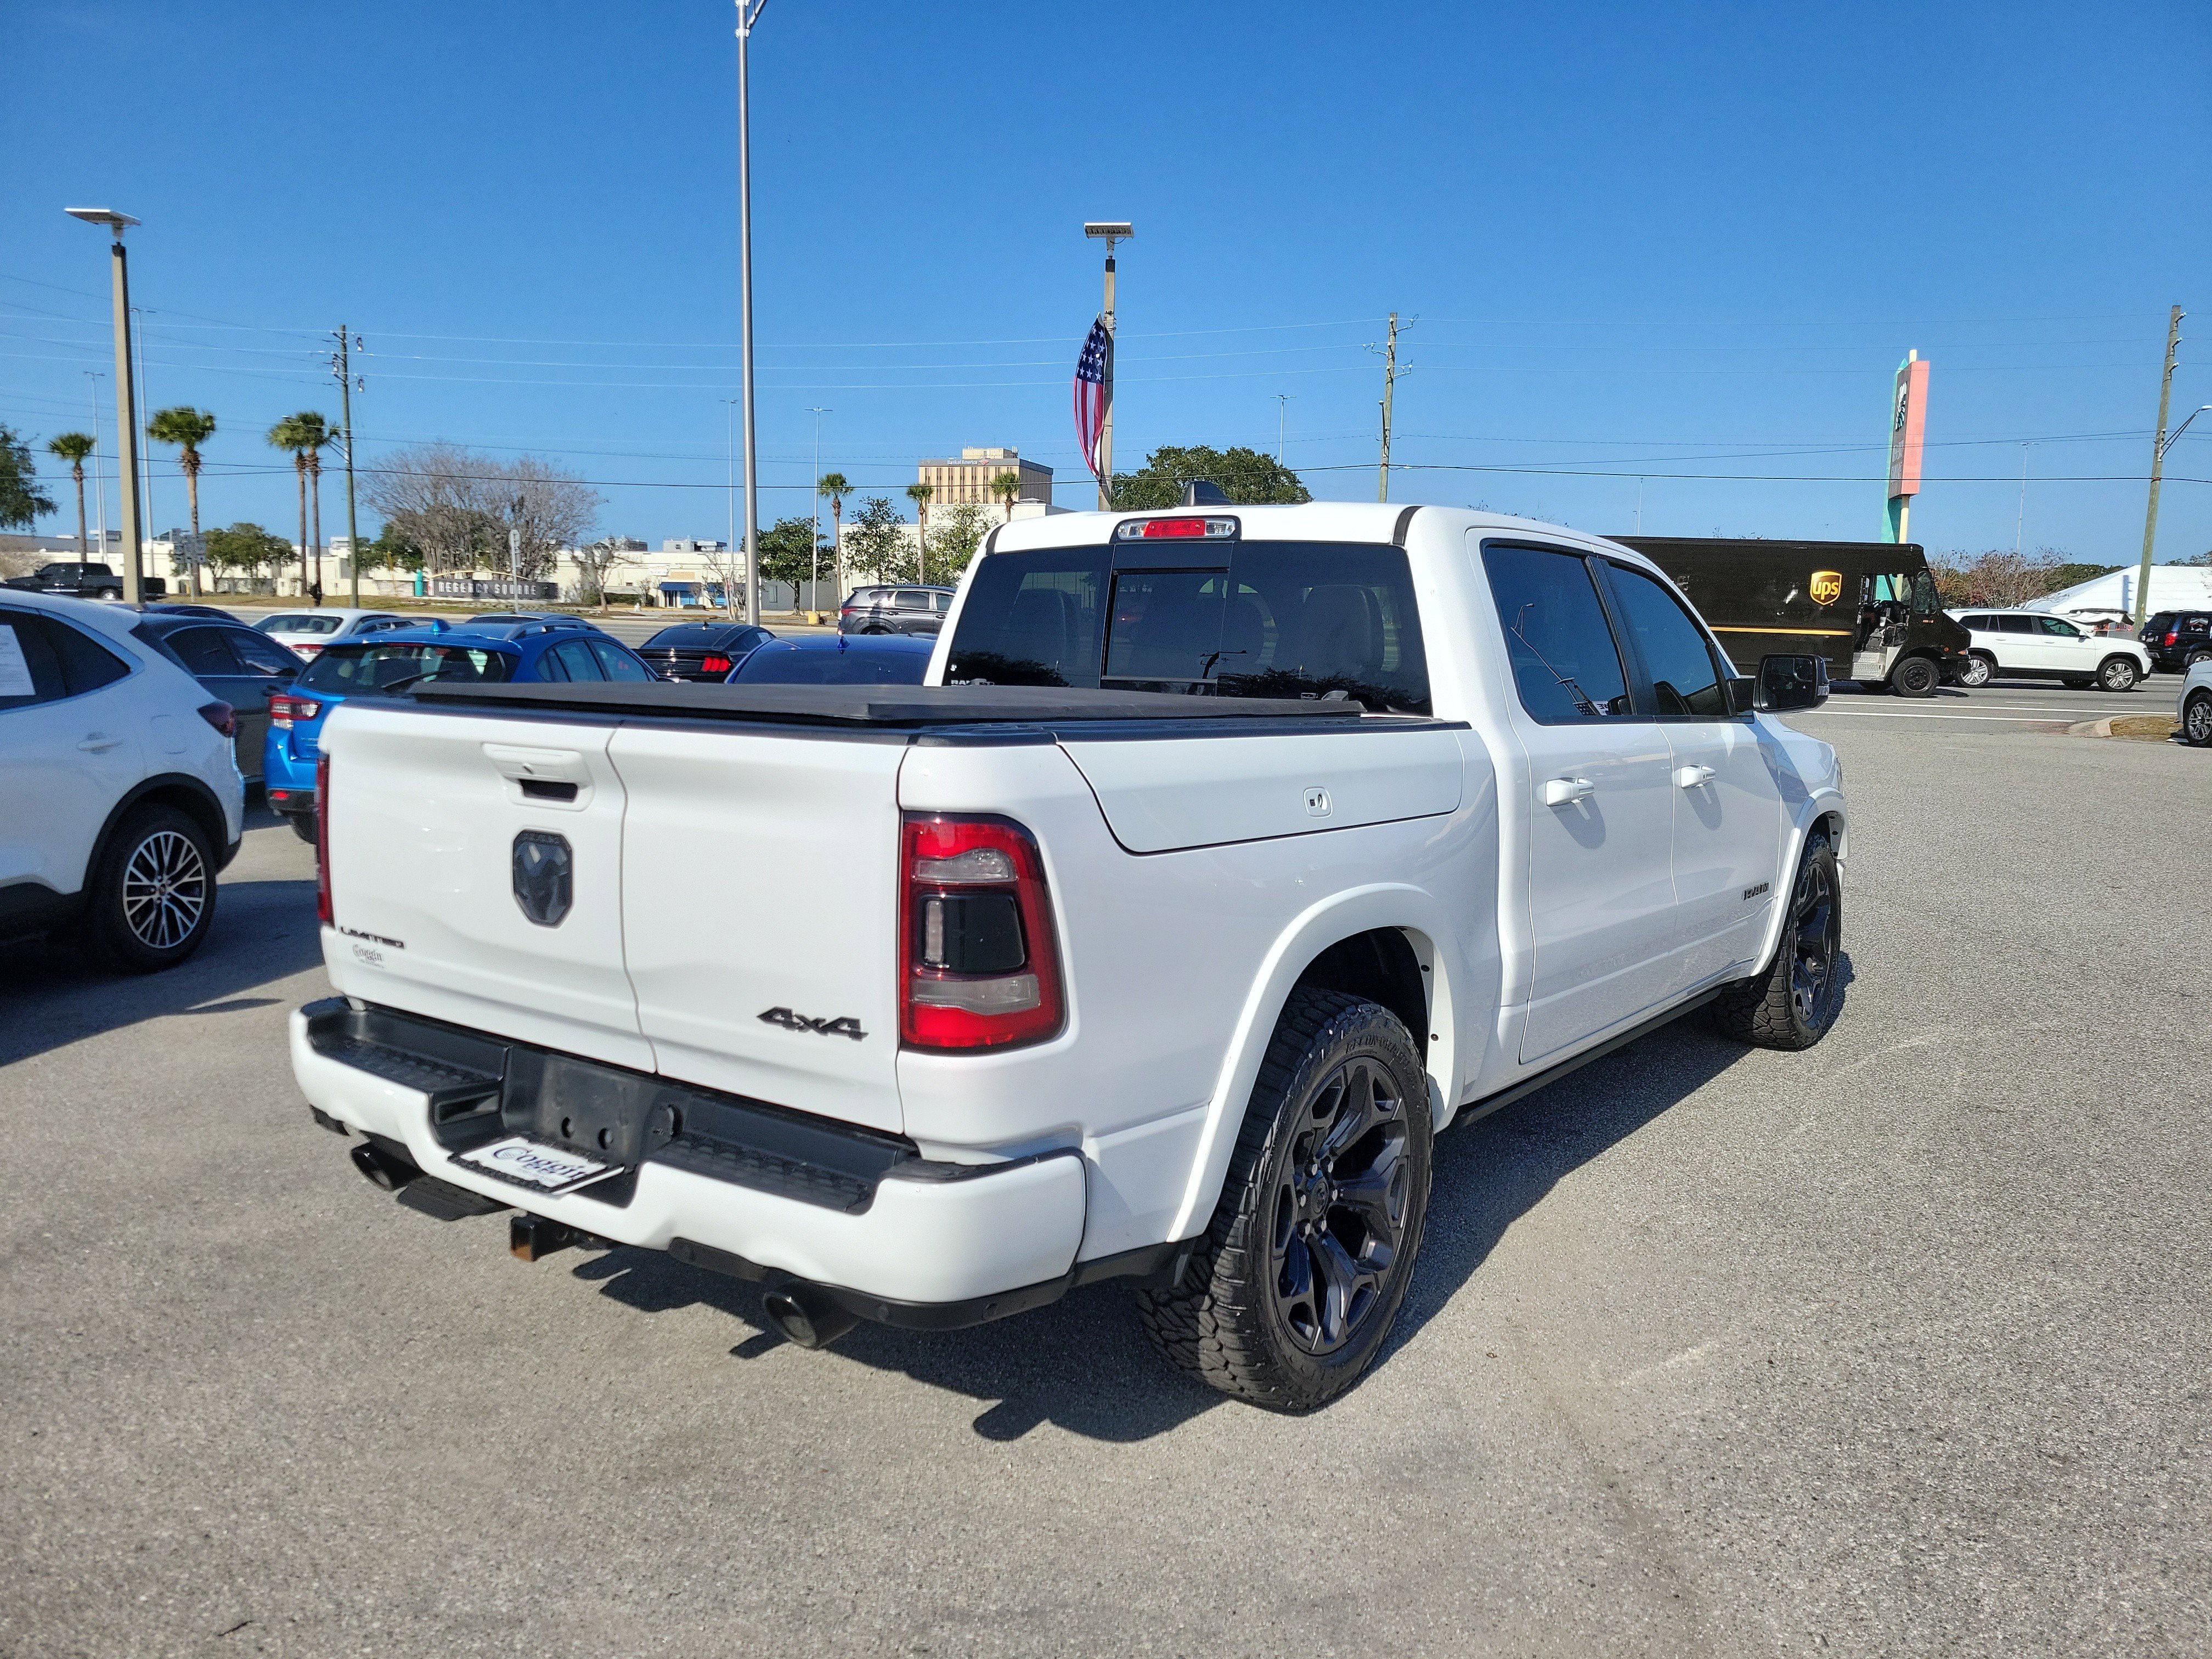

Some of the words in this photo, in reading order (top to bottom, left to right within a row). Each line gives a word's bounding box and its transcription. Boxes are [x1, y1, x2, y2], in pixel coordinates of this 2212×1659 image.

[438, 581, 489, 594] REGENCY
[494, 584, 537, 595] SQUARE
[1812, 582, 1839, 600] ups
[1743, 882, 1769, 901] RAM
[493, 1146, 586, 1181] Coggin
